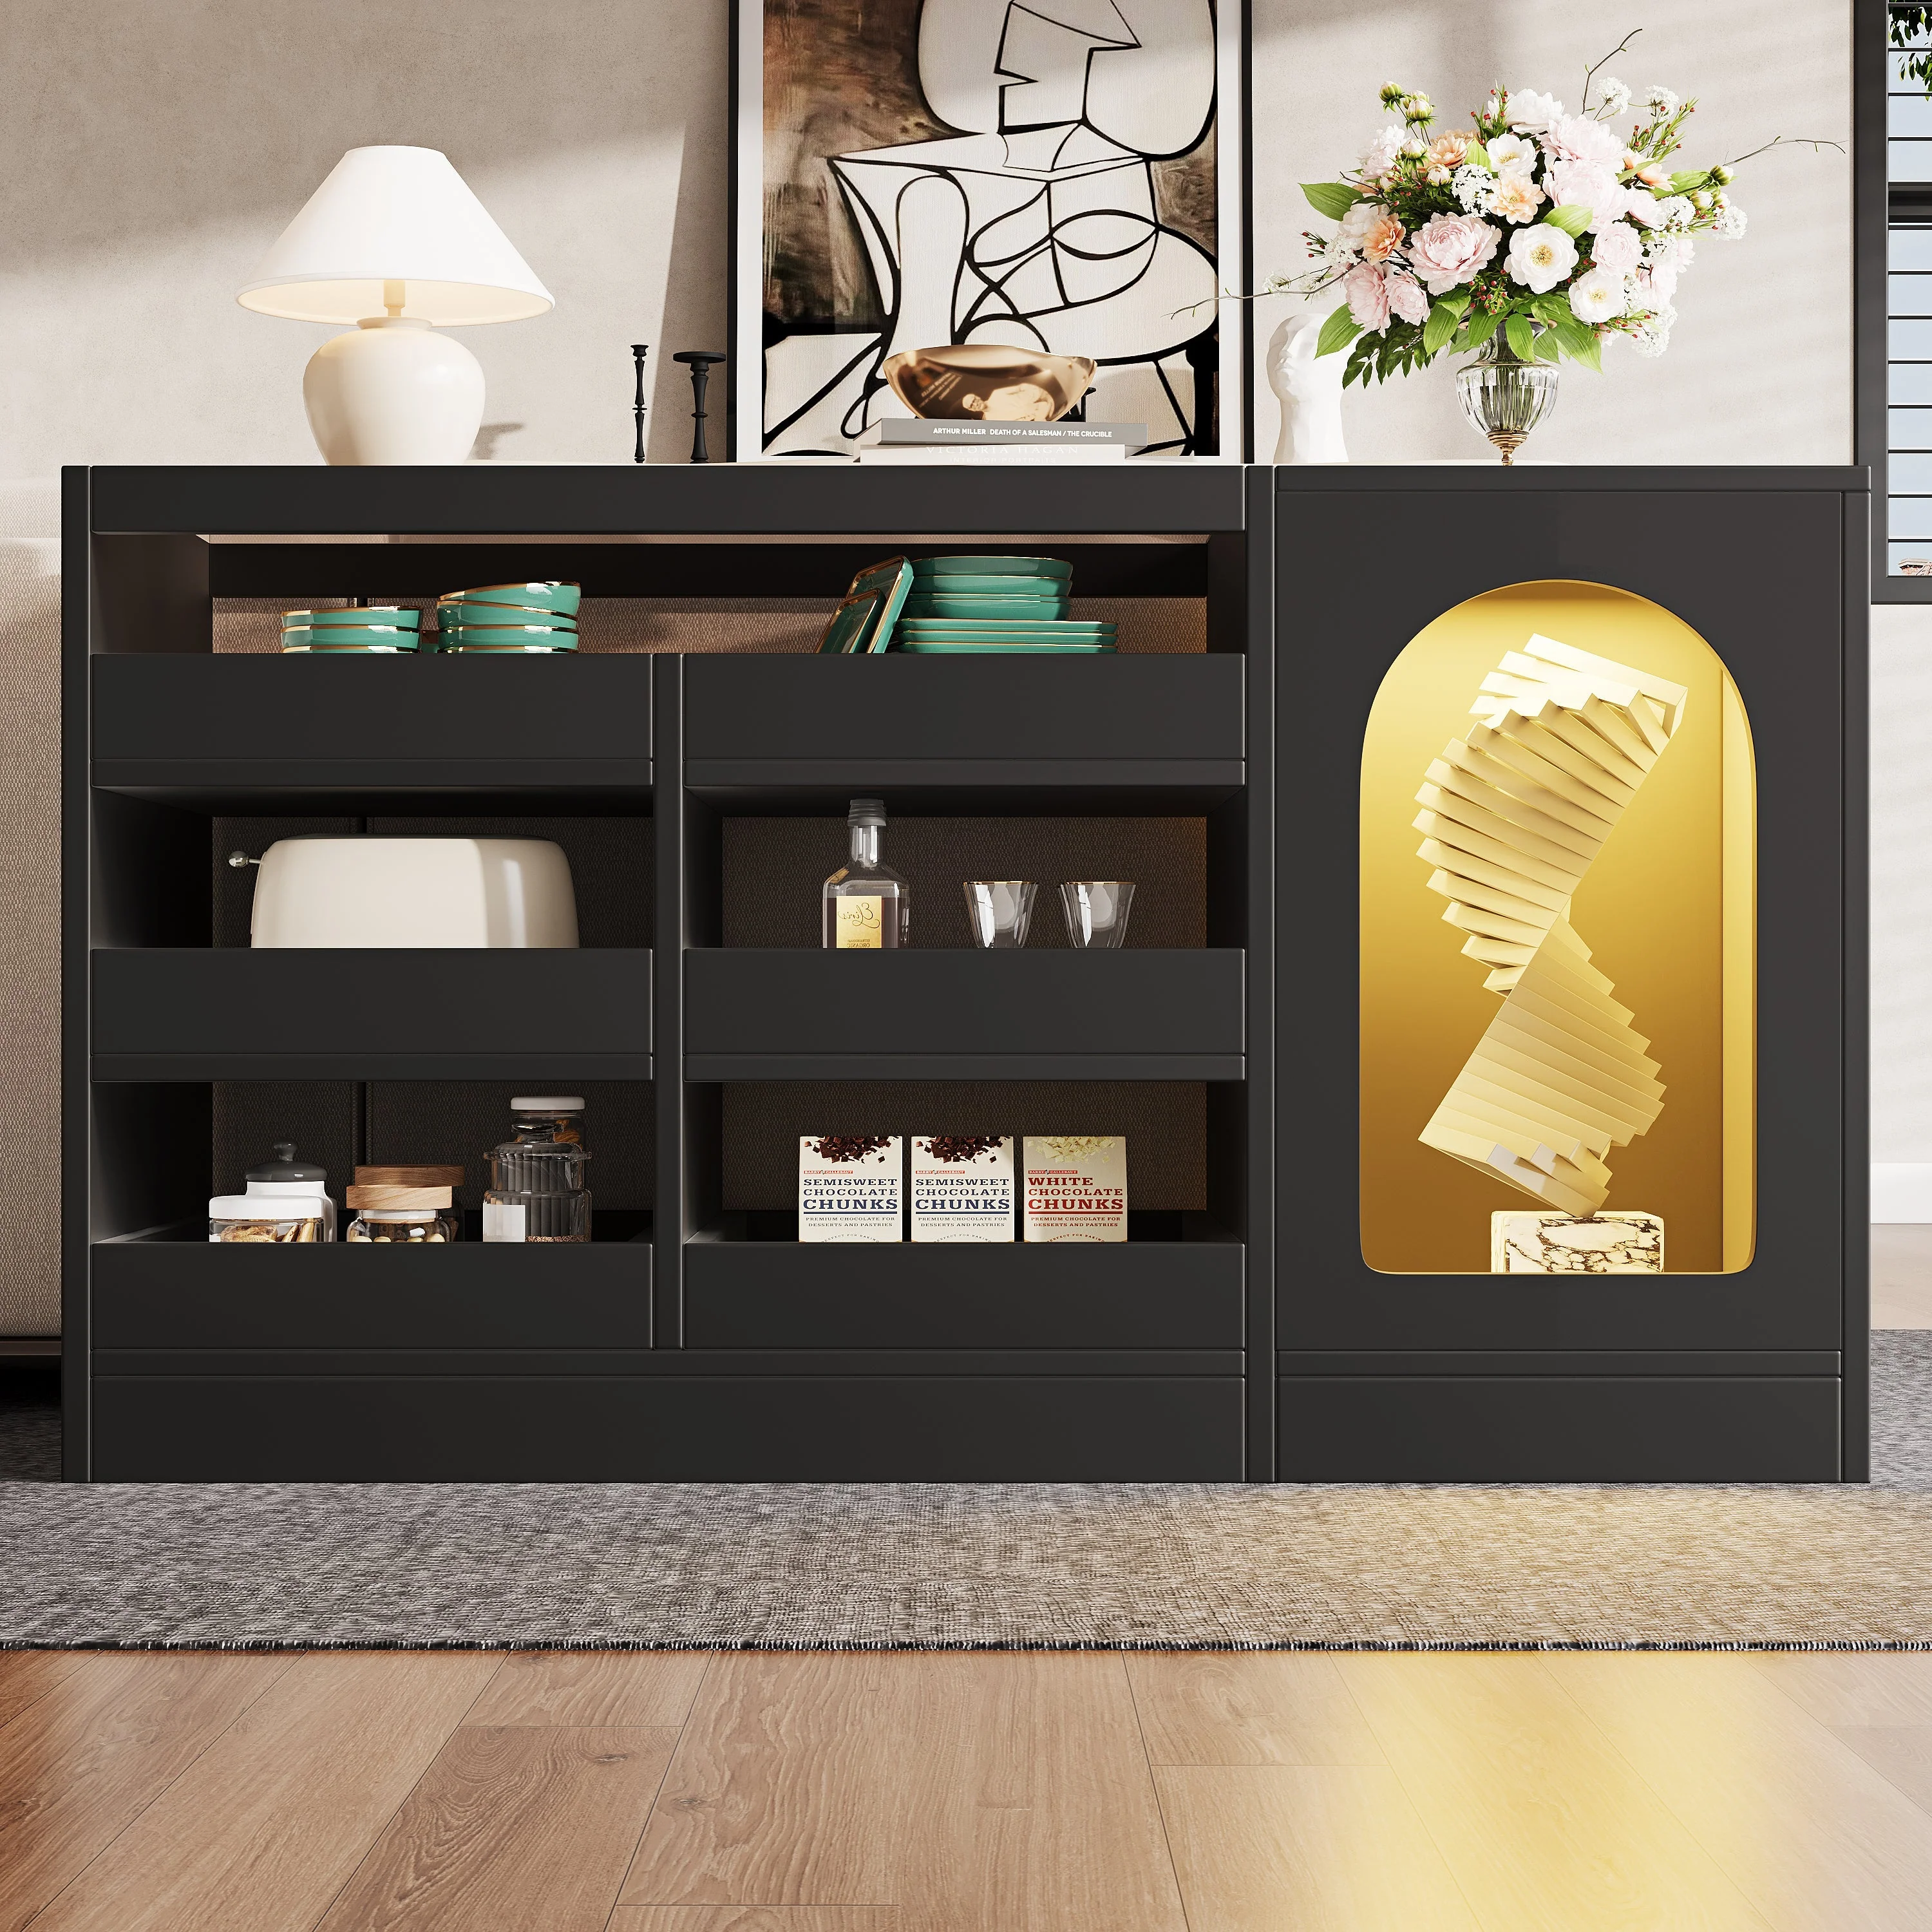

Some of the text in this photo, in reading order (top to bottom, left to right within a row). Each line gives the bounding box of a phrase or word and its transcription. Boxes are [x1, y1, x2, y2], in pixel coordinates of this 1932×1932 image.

[1028, 1177, 1094, 1186] WHITE
[803, 1199, 898, 1209] CHUNKS
[915, 1199, 1010, 1209] CHUNKS
[1028, 1199, 1123, 1209] CHUNKS
[1047, 1234, 1070, 1242] ERFECT
